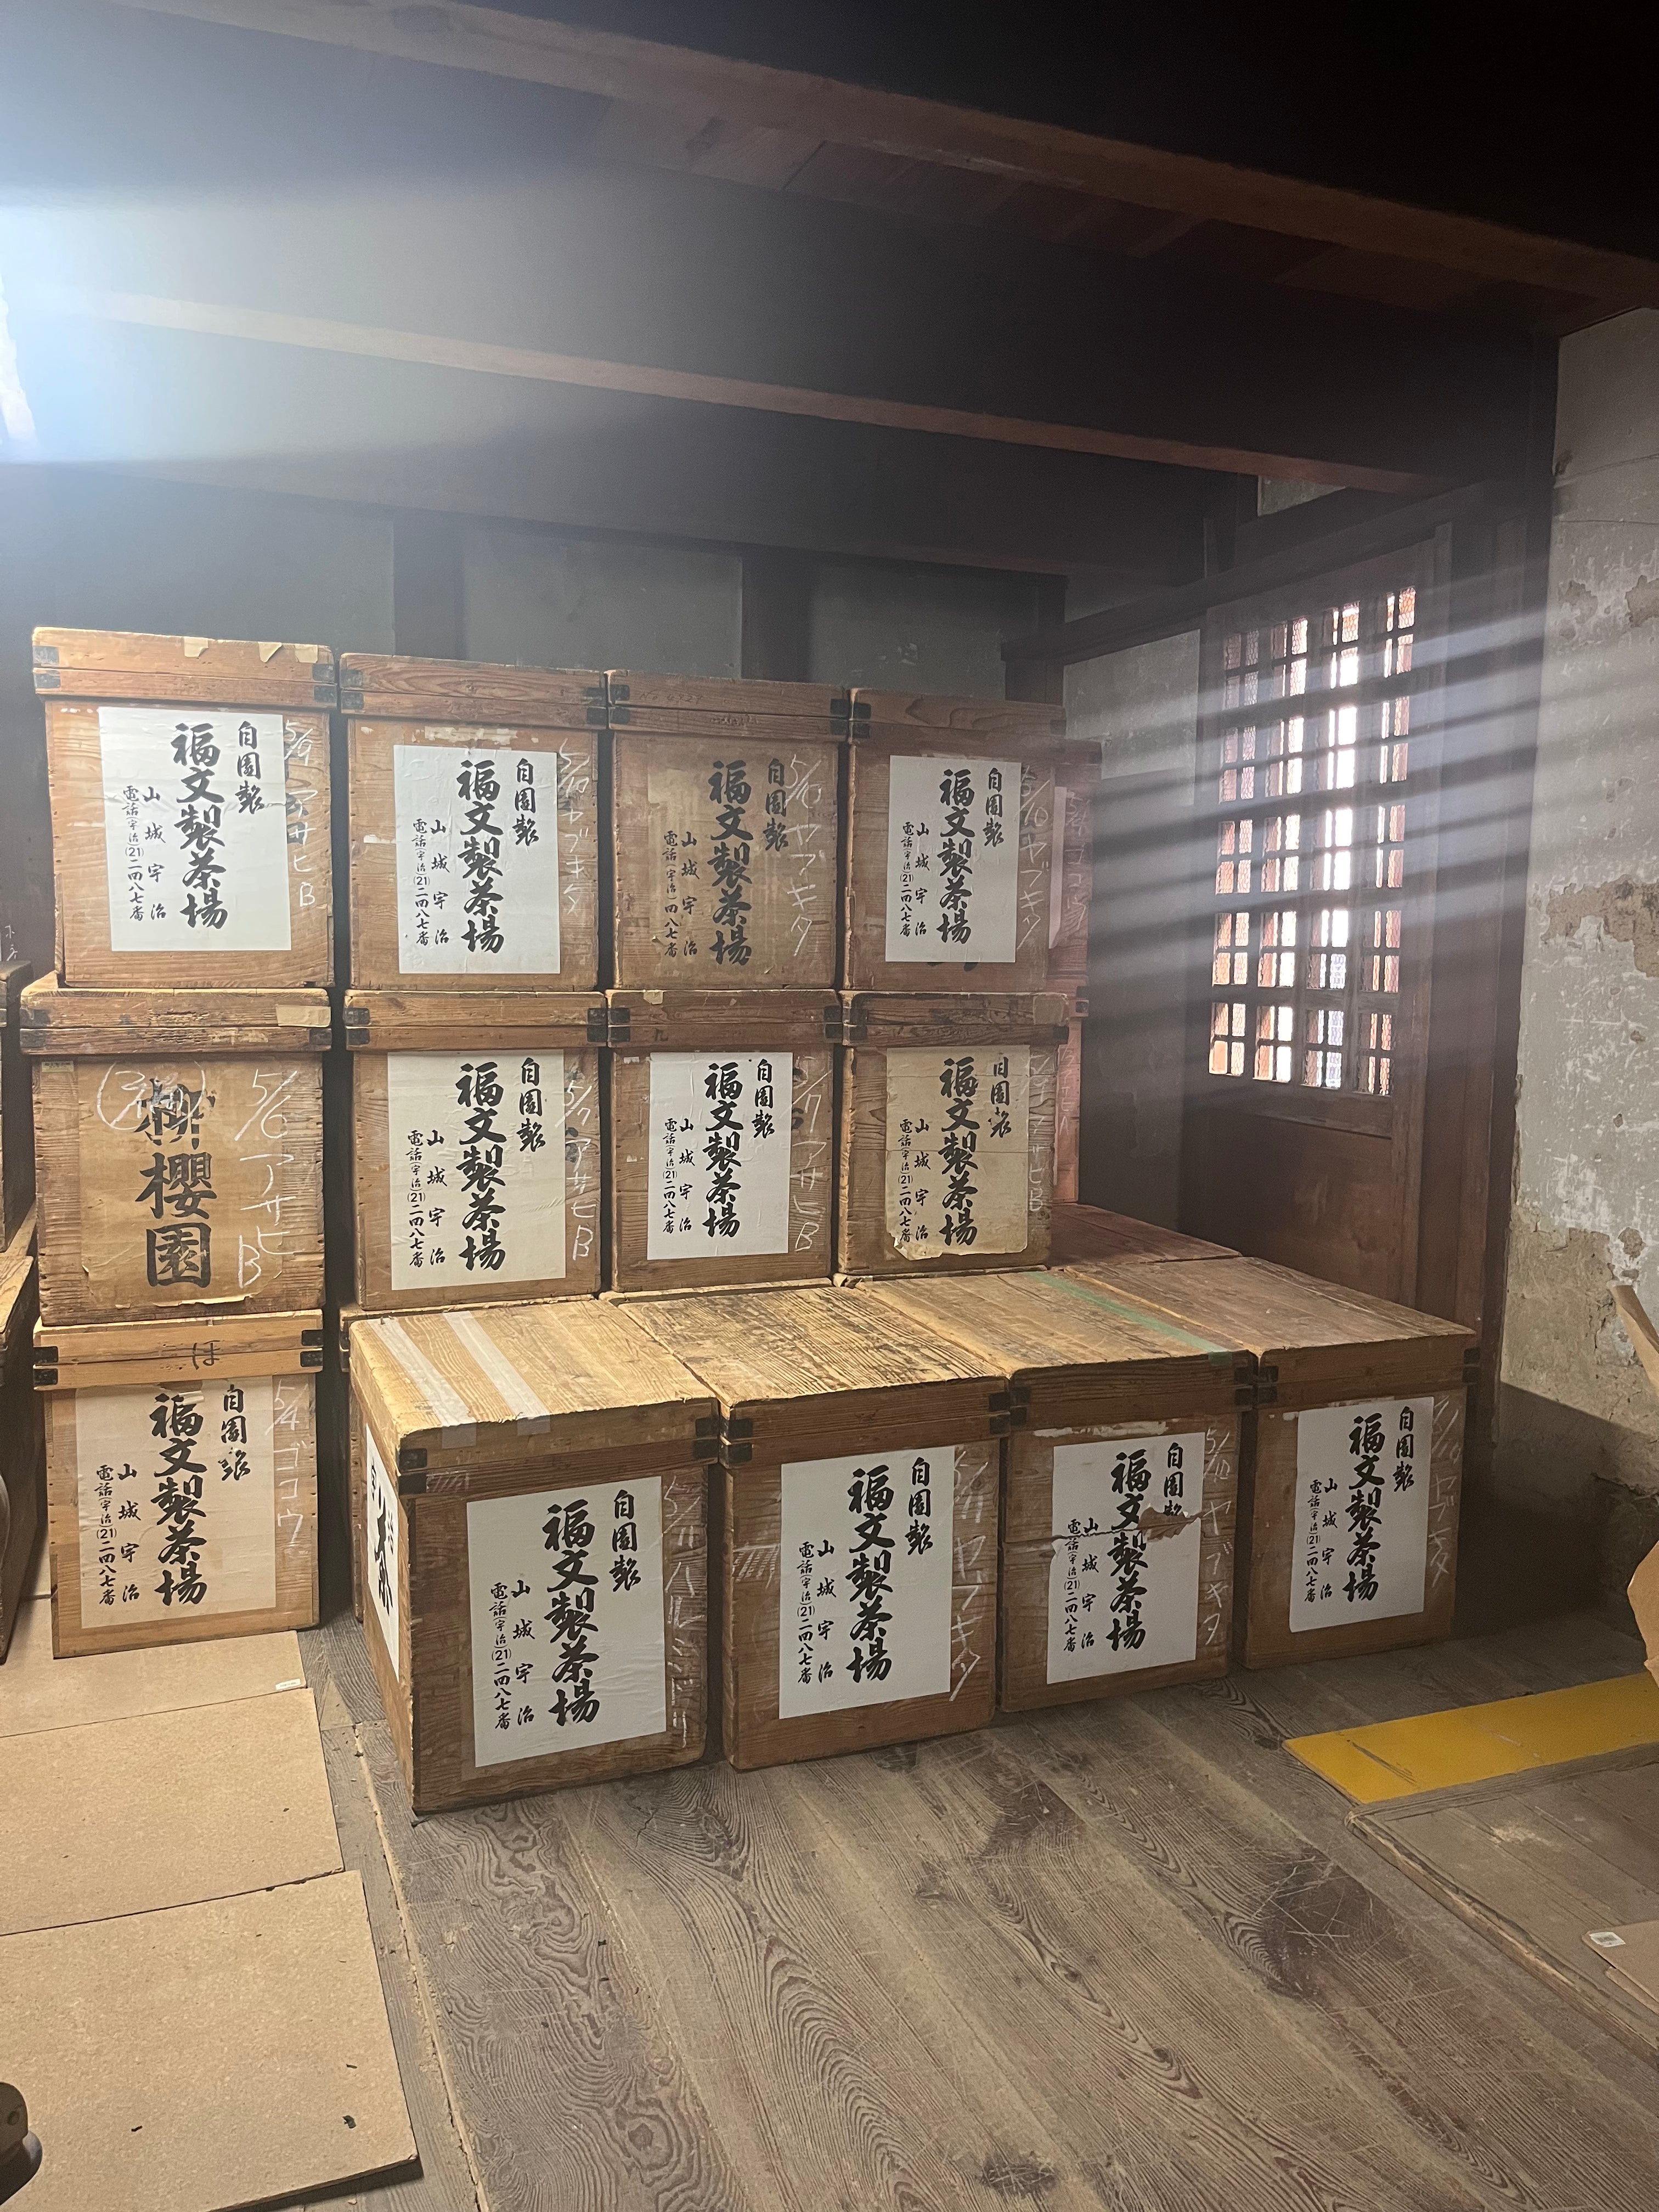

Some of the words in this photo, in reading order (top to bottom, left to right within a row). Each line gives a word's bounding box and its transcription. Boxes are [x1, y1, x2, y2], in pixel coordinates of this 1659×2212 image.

[143, 786, 167, 920] 山城宇治
[172, 722, 229, 929] 福文製茶場
[431, 820, 450, 944] 山城宇治
[456, 759, 504, 954] 福文製茶場
[681, 831, 700, 956] 山城宇治
[707, 759, 753, 966] 福文製茶場
[915, 822, 929, 936] 山城宇治
[936, 769, 975, 944] 福文製茶場
[235, 1070, 297, 1141] 5/6
[455, 1061, 507, 1271] 福文製茶場
[680, 1118, 695, 1232] 山城宇治
[702, 1062, 743, 1238] 福文製茶場
[938, 1056, 980, 1246] 福文製茶場
[427, 1130, 447, 1265] 山城宇治
[915, 1118, 931, 1241] 山城宇治
[117, 1463, 142, 1601] 山城宇治
[150, 1393, 208, 1606] 福文製茶場
[1321, 1478, 1338, 1599] 山城宇治
[1342, 1413, 1386, 1603] 福文製茶場
[541, 1498, 600, 1726] 福文製茶場
[816, 1539, 837, 1684] 山城宇治
[845, 1464, 896, 1684] 福文製茶場
[1081, 1518, 1099, 1647] 山城宇治
[511, 1579, 535, 1724] 山城宇治
